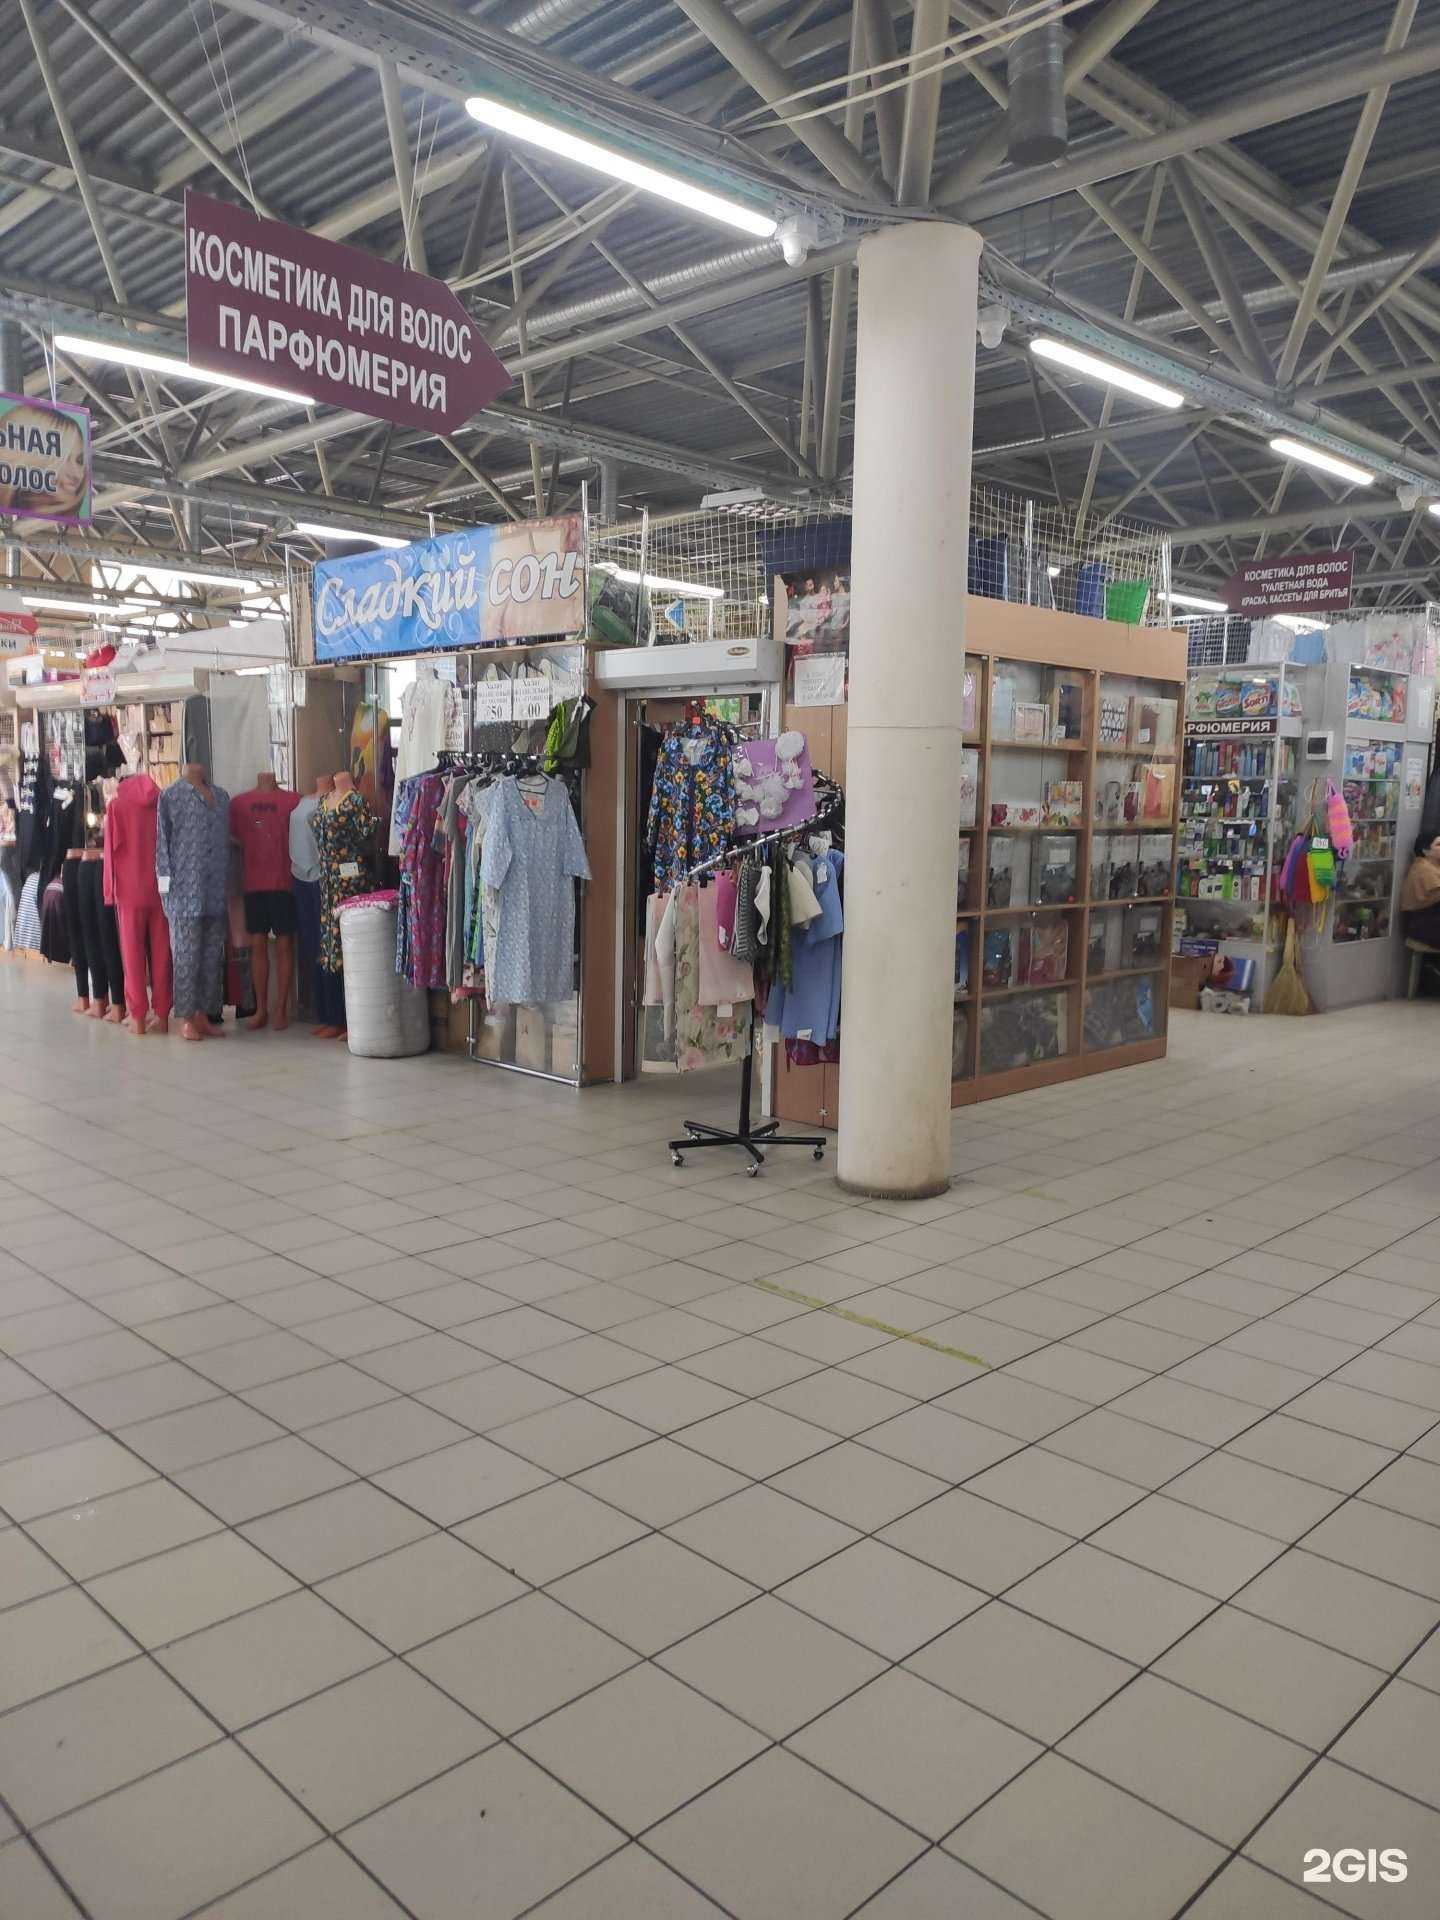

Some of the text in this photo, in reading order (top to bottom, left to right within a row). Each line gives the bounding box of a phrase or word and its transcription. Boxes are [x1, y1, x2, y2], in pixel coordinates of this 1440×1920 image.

[190, 227, 472, 364] КОСМЕТИКА ДЛЯ ВОЛОС
[219, 304, 447, 413] ПАРФЮМЕРИЯ
[1244, 560, 1348, 582] КОСМЕТИКА ДЛЯ ВОЛОС
[315, 546, 582, 637] Сладкий сон
[1261, 577, 1329, 593] ТУАЛЕТНАЯ ВОДА
[1269, 592, 1303, 604] КАССЕТЫ
[1303, 590, 1318, 601] ДЛЯ
[1319, 587, 1349, 600] БРИТЬЯ
[1185, 720, 1271, 734] РФЮМЕРИЯ
